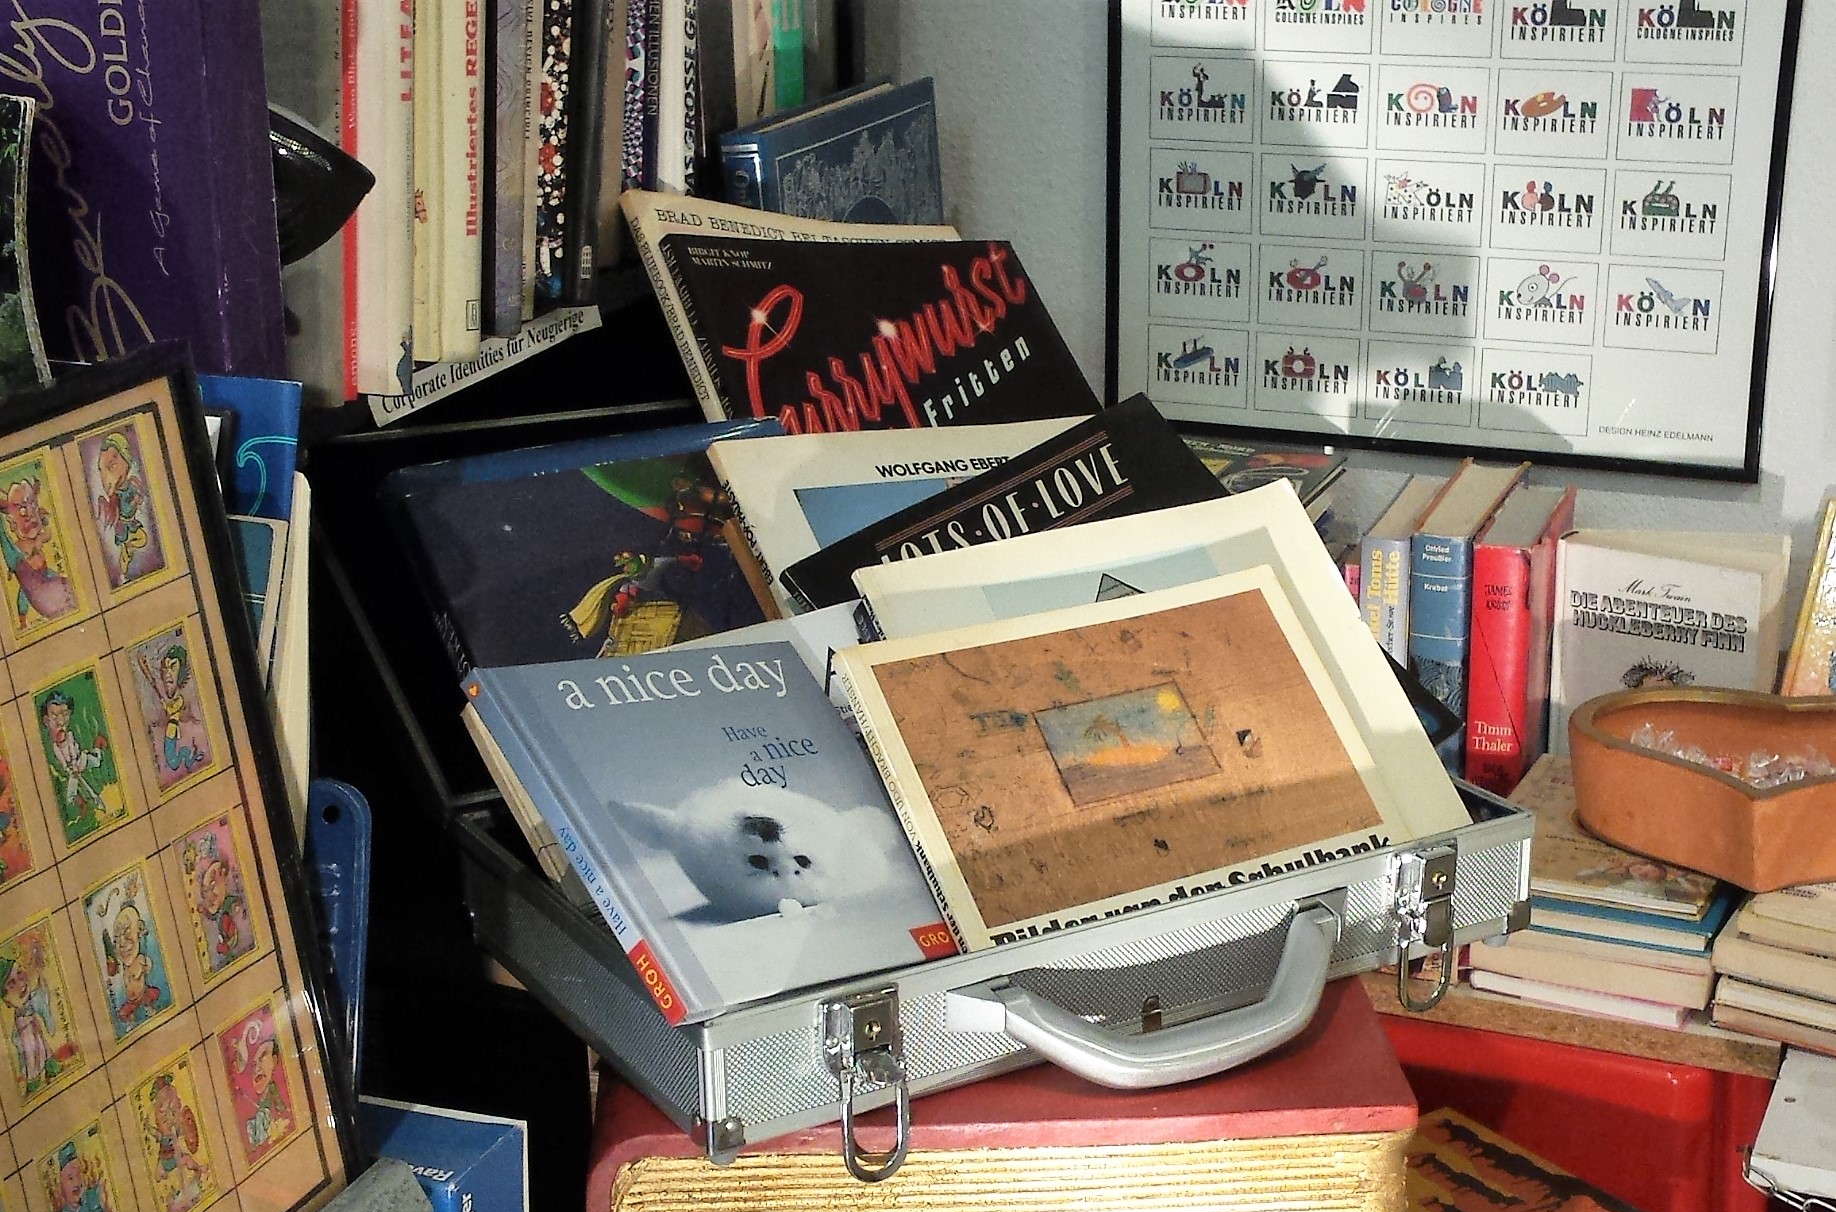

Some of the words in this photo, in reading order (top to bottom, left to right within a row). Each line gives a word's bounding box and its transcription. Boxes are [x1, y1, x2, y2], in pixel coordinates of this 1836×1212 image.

[1161, 4, 1248, 21] INSPIRIERT
[1275, 12, 1318, 25] COLOGNE
[1319, 13, 1365, 26] INSPIRES
[1510, 27, 1606, 44] INSPIRIERT
[1636, 26, 1683, 41] COLOGNE
[1685, 28, 1736, 43] INSPIRES
[648, 29, 661, 116] ILLUSIONEN
[684, 45, 697, 152] GROSSE
[1160, 107, 1245, 125] INSPIRIERT
[1270, 106, 1359, 125] INSPIRIERT
[1386, 112, 1477, 129] INSPIRIERT
[1502, 116, 1597, 135] INSPIRIERT
[1628, 123, 1725, 141] INSPIRIERT
[465, 86, 479, 237] Illustriertes
[1158, 194, 1243, 211] INSPIRIERT
[1269, 200, 1357, 218] INSPIRIERT
[654, 208, 702, 227] BRAD
[707, 216, 786, 241] BENEDICT
[1384, 206, 1474, 224] INSPIRIERT
[1501, 211, 1593, 229] INSPIRIERT
[1620, 217, 1716, 236] INSPIRIERT
[152, 246, 171, 276] A
[1157, 280, 1241, 299] INSPIRIERT
[1268, 288, 1354, 307] INSPIRIERT
[1379, 298, 1468, 317] INSPIRIERT
[1497, 307, 1585, 325] INSPIRIERT
[1615, 312, 1710, 332] INSPIRIERT
[382, 371, 448, 415] Corporate
[449, 344, 504, 385] Identities
[506, 332, 525, 360] für
[526, 308, 585, 343] Neugierige
[921, 333, 1033, 429] Fritten
[1157, 367, 1239, 388] INSPIRIERT
[1263, 375, 1349, 395] INSPIRIERT
[1375, 386, 1462, 406] INSPIRIERT
[1489, 389, 1580, 409] INSPIRIERT
[1598, 425, 1633, 438] DESIGN
[1635, 428, 1662, 439] HEINZ
[1663, 430, 1714, 443] EDELMANN
[875, 457, 969, 478] WOLFGANG
[880, 519, 972, 566] OTS
[1617, 578, 1654, 598] Mark
[1570, 590, 1599, 611] DIE
[1600, 594, 1708, 630] ABENTEUER
[1710, 611, 1748, 634] DES
[1573, 609, 1699, 646] HUCKLEBERRY
[1700, 629, 1746, 653] FINN
[557, 677, 595, 711] a
[595, 661, 702, 707] nice
[706, 652, 791, 697] day
[721, 723, 768, 744] Have
[1474, 720, 1512, 737] Timm
[748, 747, 763, 763] a
[763, 733, 820, 761] nice
[1472, 736, 1514, 753] Thaler
[740, 761, 790, 790] day
[559, 826, 577, 853] day
[575, 854, 597, 884] nice
[595, 886, 605, 897] a
[602, 897, 627, 936] Have
[636, 953, 673, 1010] GROH
